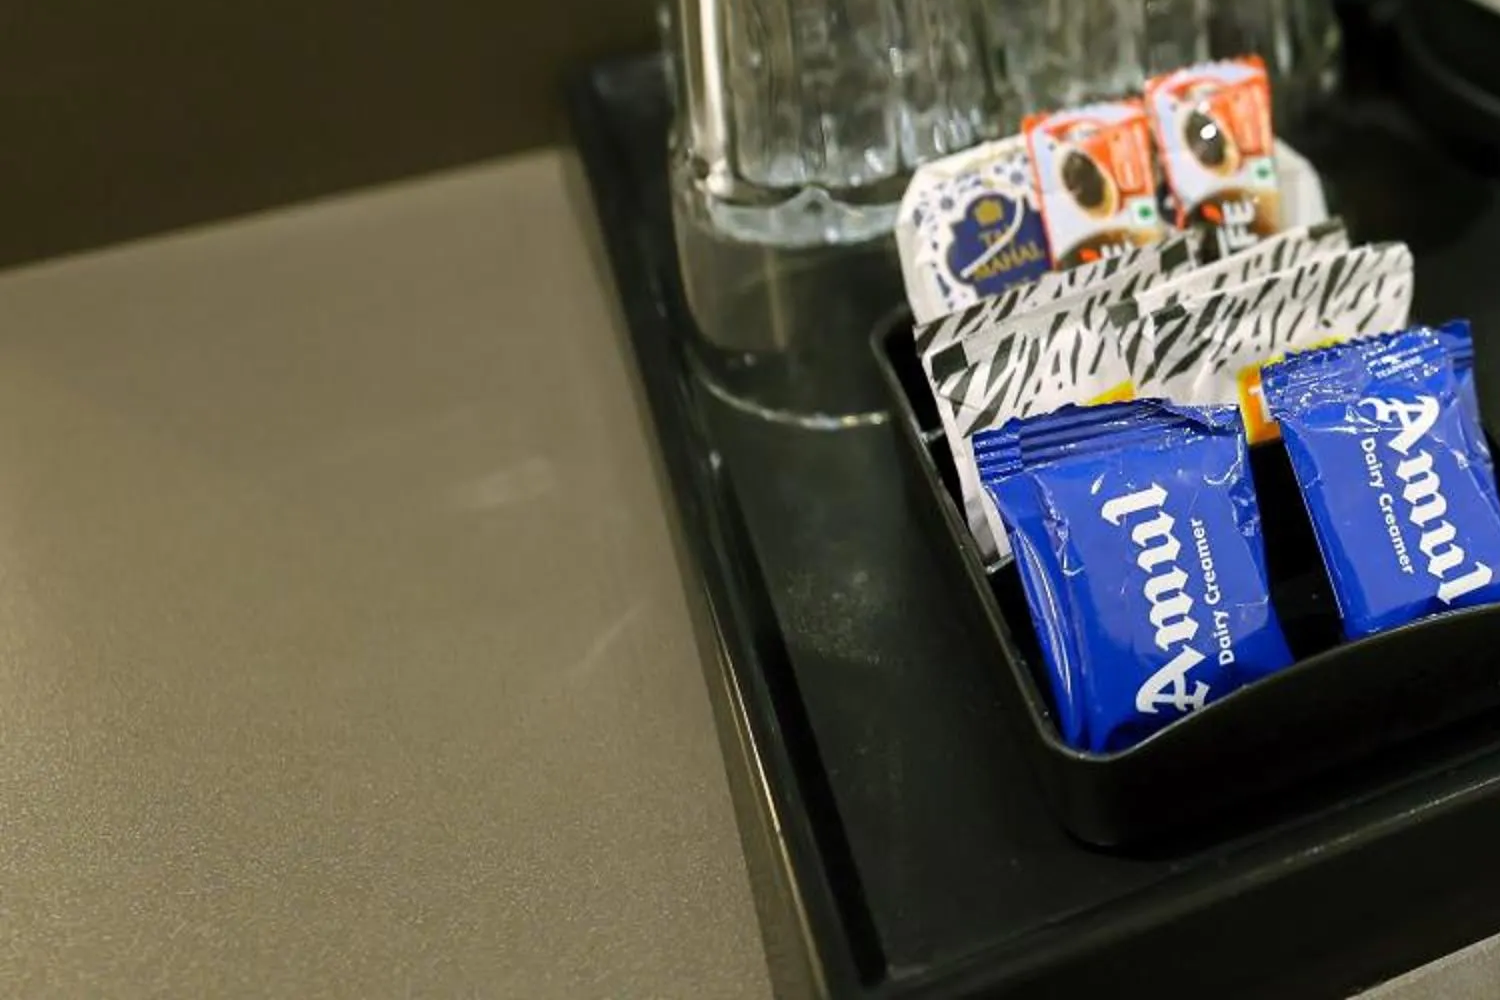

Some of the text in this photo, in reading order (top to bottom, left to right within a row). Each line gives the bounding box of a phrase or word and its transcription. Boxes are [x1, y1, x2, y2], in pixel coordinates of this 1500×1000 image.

[1357, 395, 1493, 605] Amul
[1360, 437, 1415, 575] Dairy Creamer
[1101, 482, 1210, 713] Amul
[1190, 518, 1235, 666] Dairy Creamer
